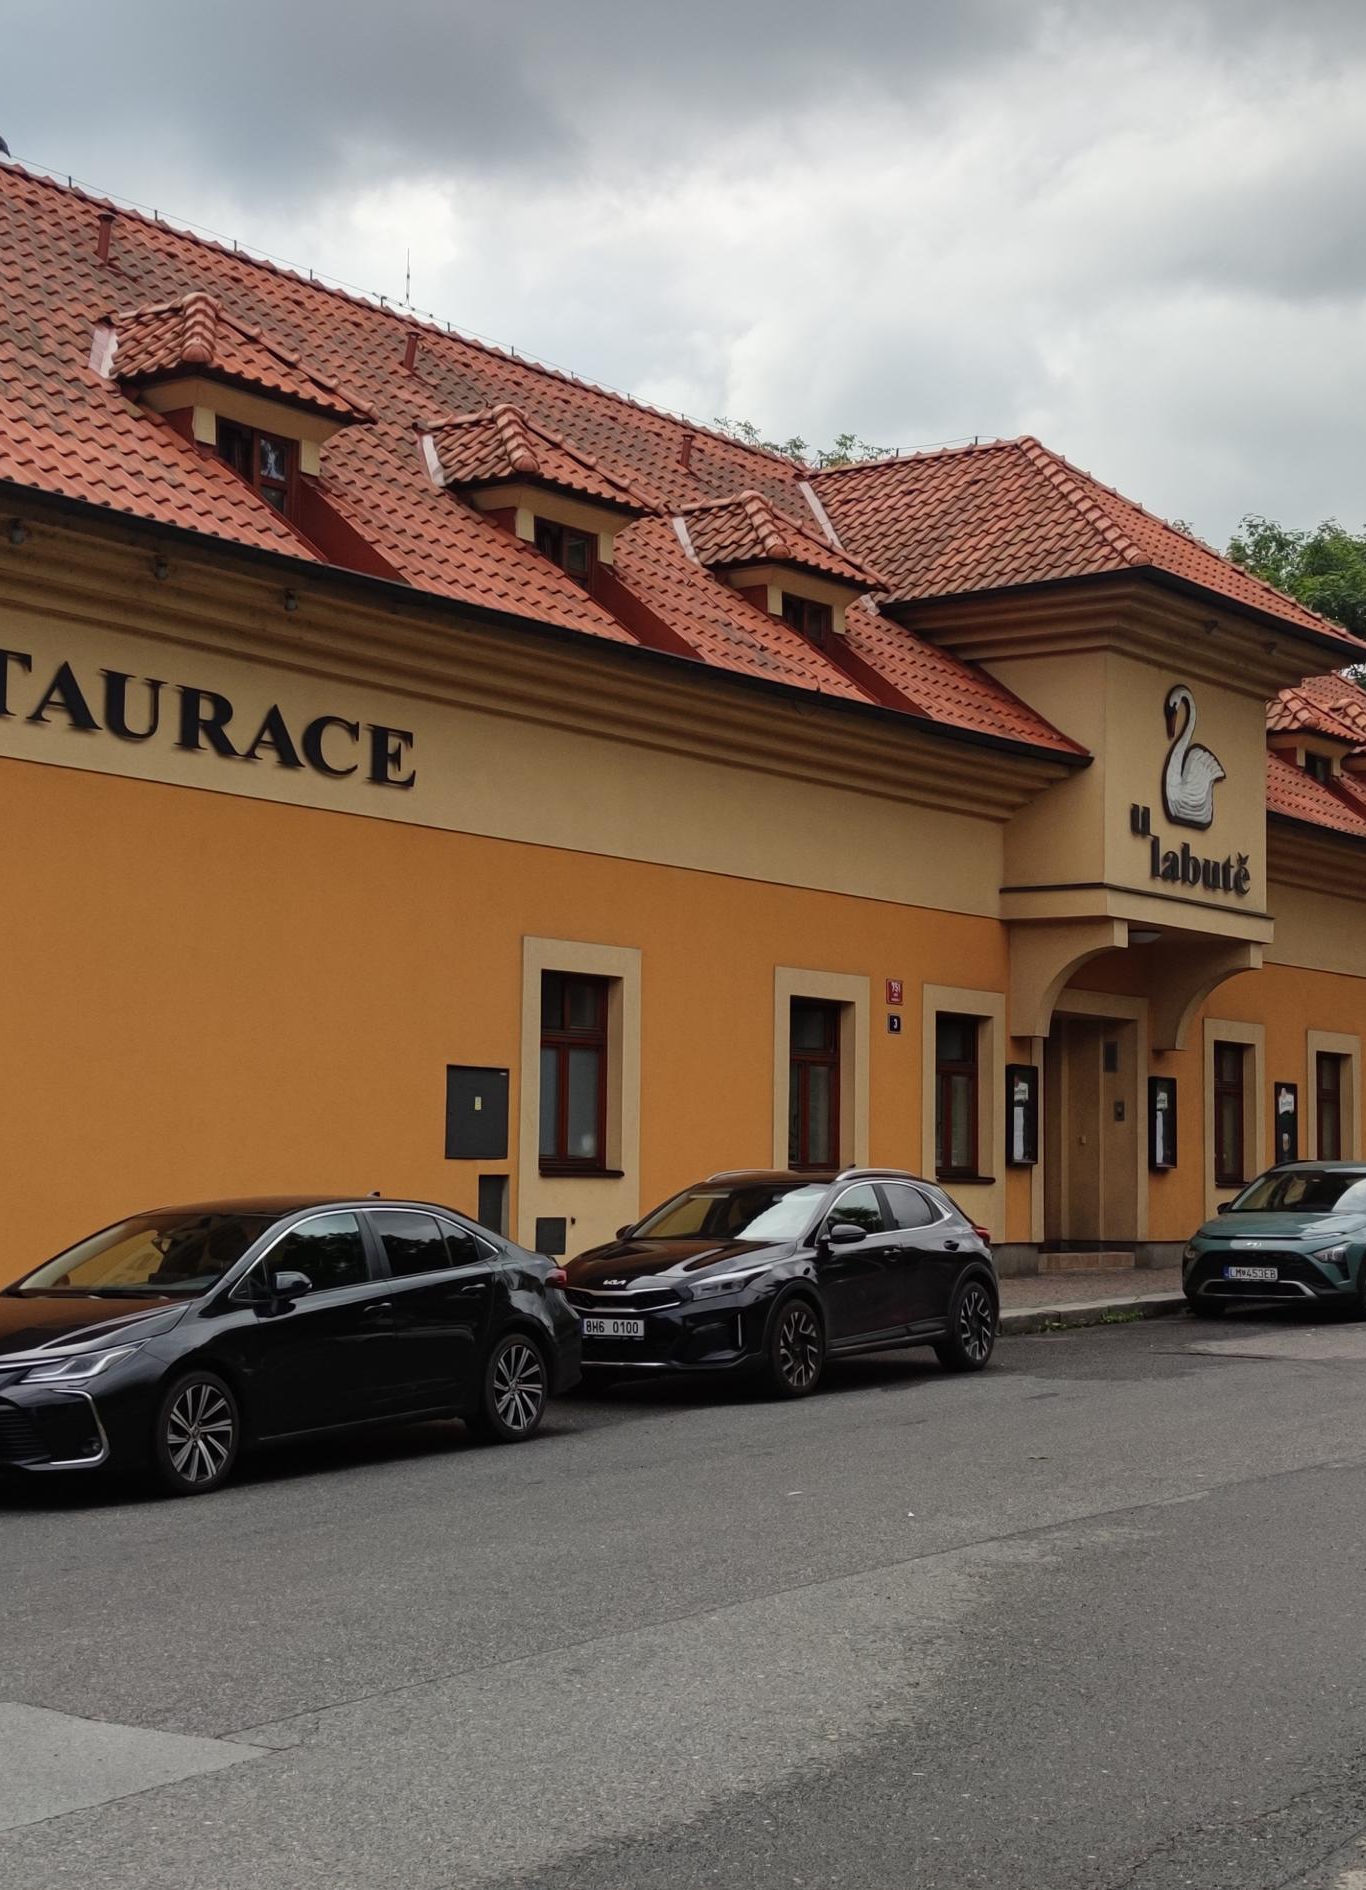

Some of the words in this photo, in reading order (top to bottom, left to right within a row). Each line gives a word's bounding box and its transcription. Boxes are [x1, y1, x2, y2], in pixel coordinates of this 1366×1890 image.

[1130, 803, 1152, 836] u
[1150, 835, 1251, 895] labutě
[613, 1322, 639, 1334] 0100
